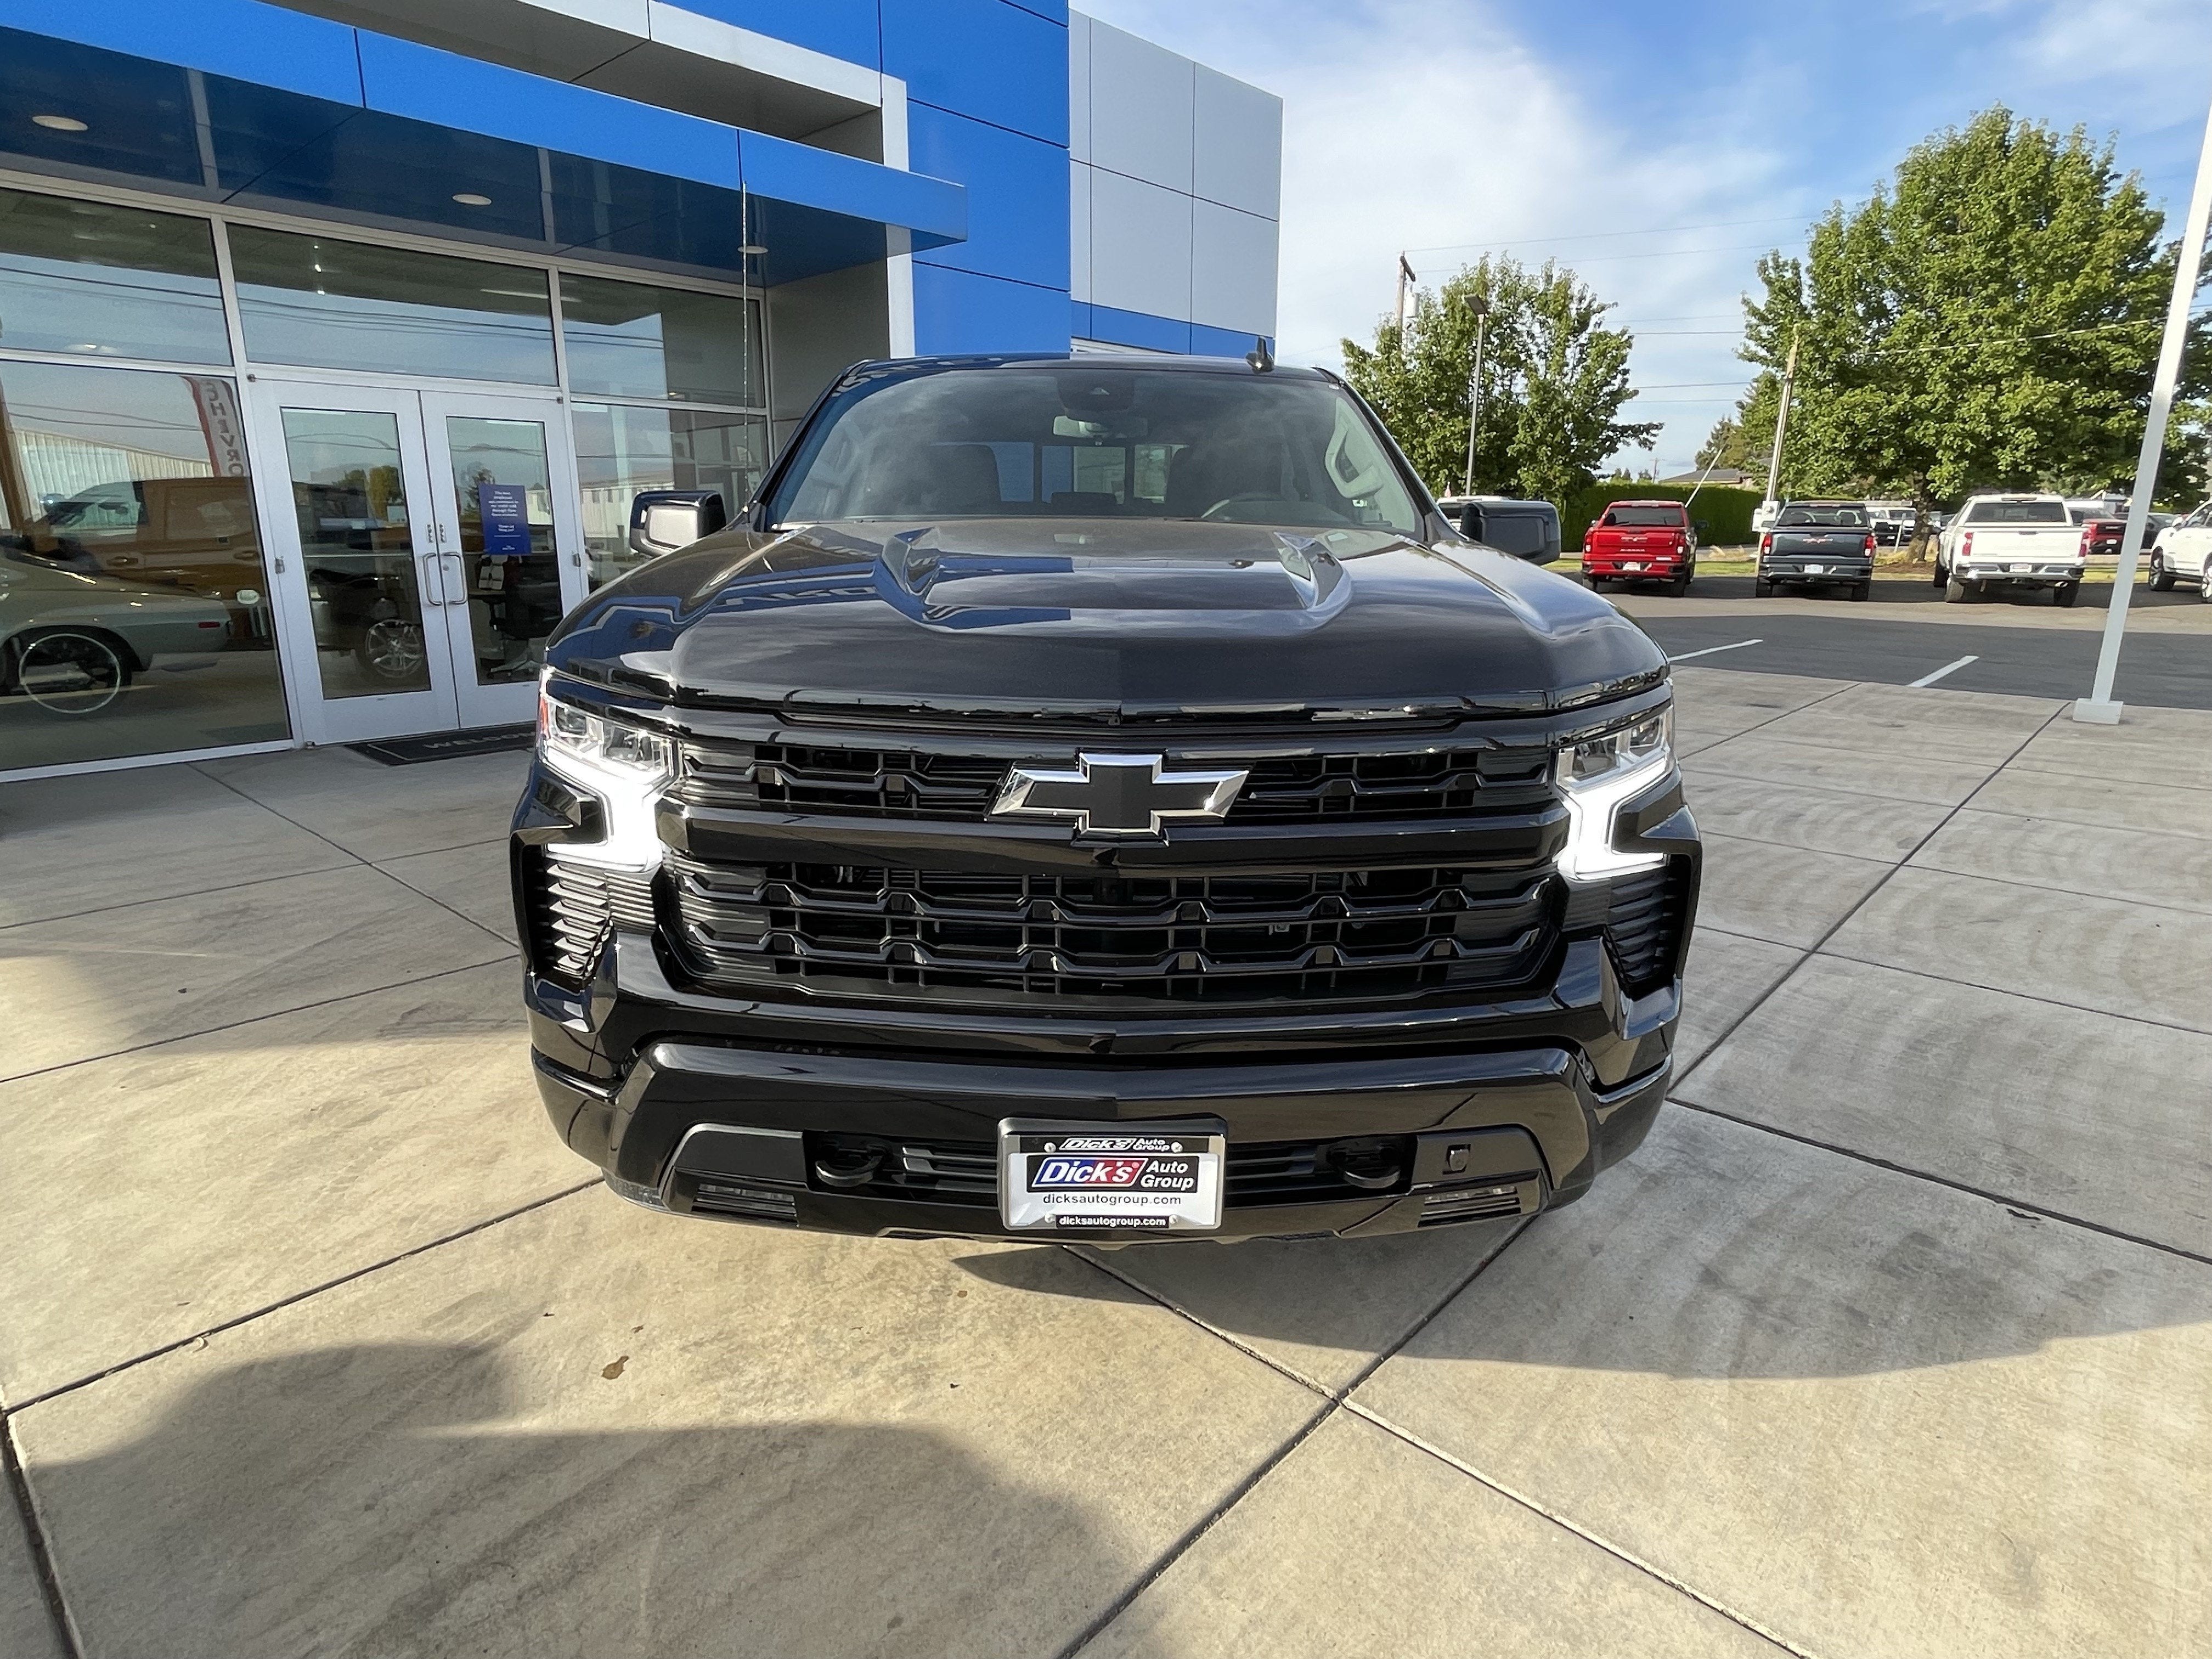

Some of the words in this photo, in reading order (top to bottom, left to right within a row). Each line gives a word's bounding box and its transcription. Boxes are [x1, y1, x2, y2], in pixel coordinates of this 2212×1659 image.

[422, 731, 536, 749] WELCOM
[1040, 1161, 1133, 1183] Dick's
[1146, 1160, 1188, 1174] Auto
[1140, 1174, 1194, 1191] Group
[1043, 1194, 1181, 1206] dicksautogroup.com
[1059, 1216, 1166, 1227] dicksautogroup.com
